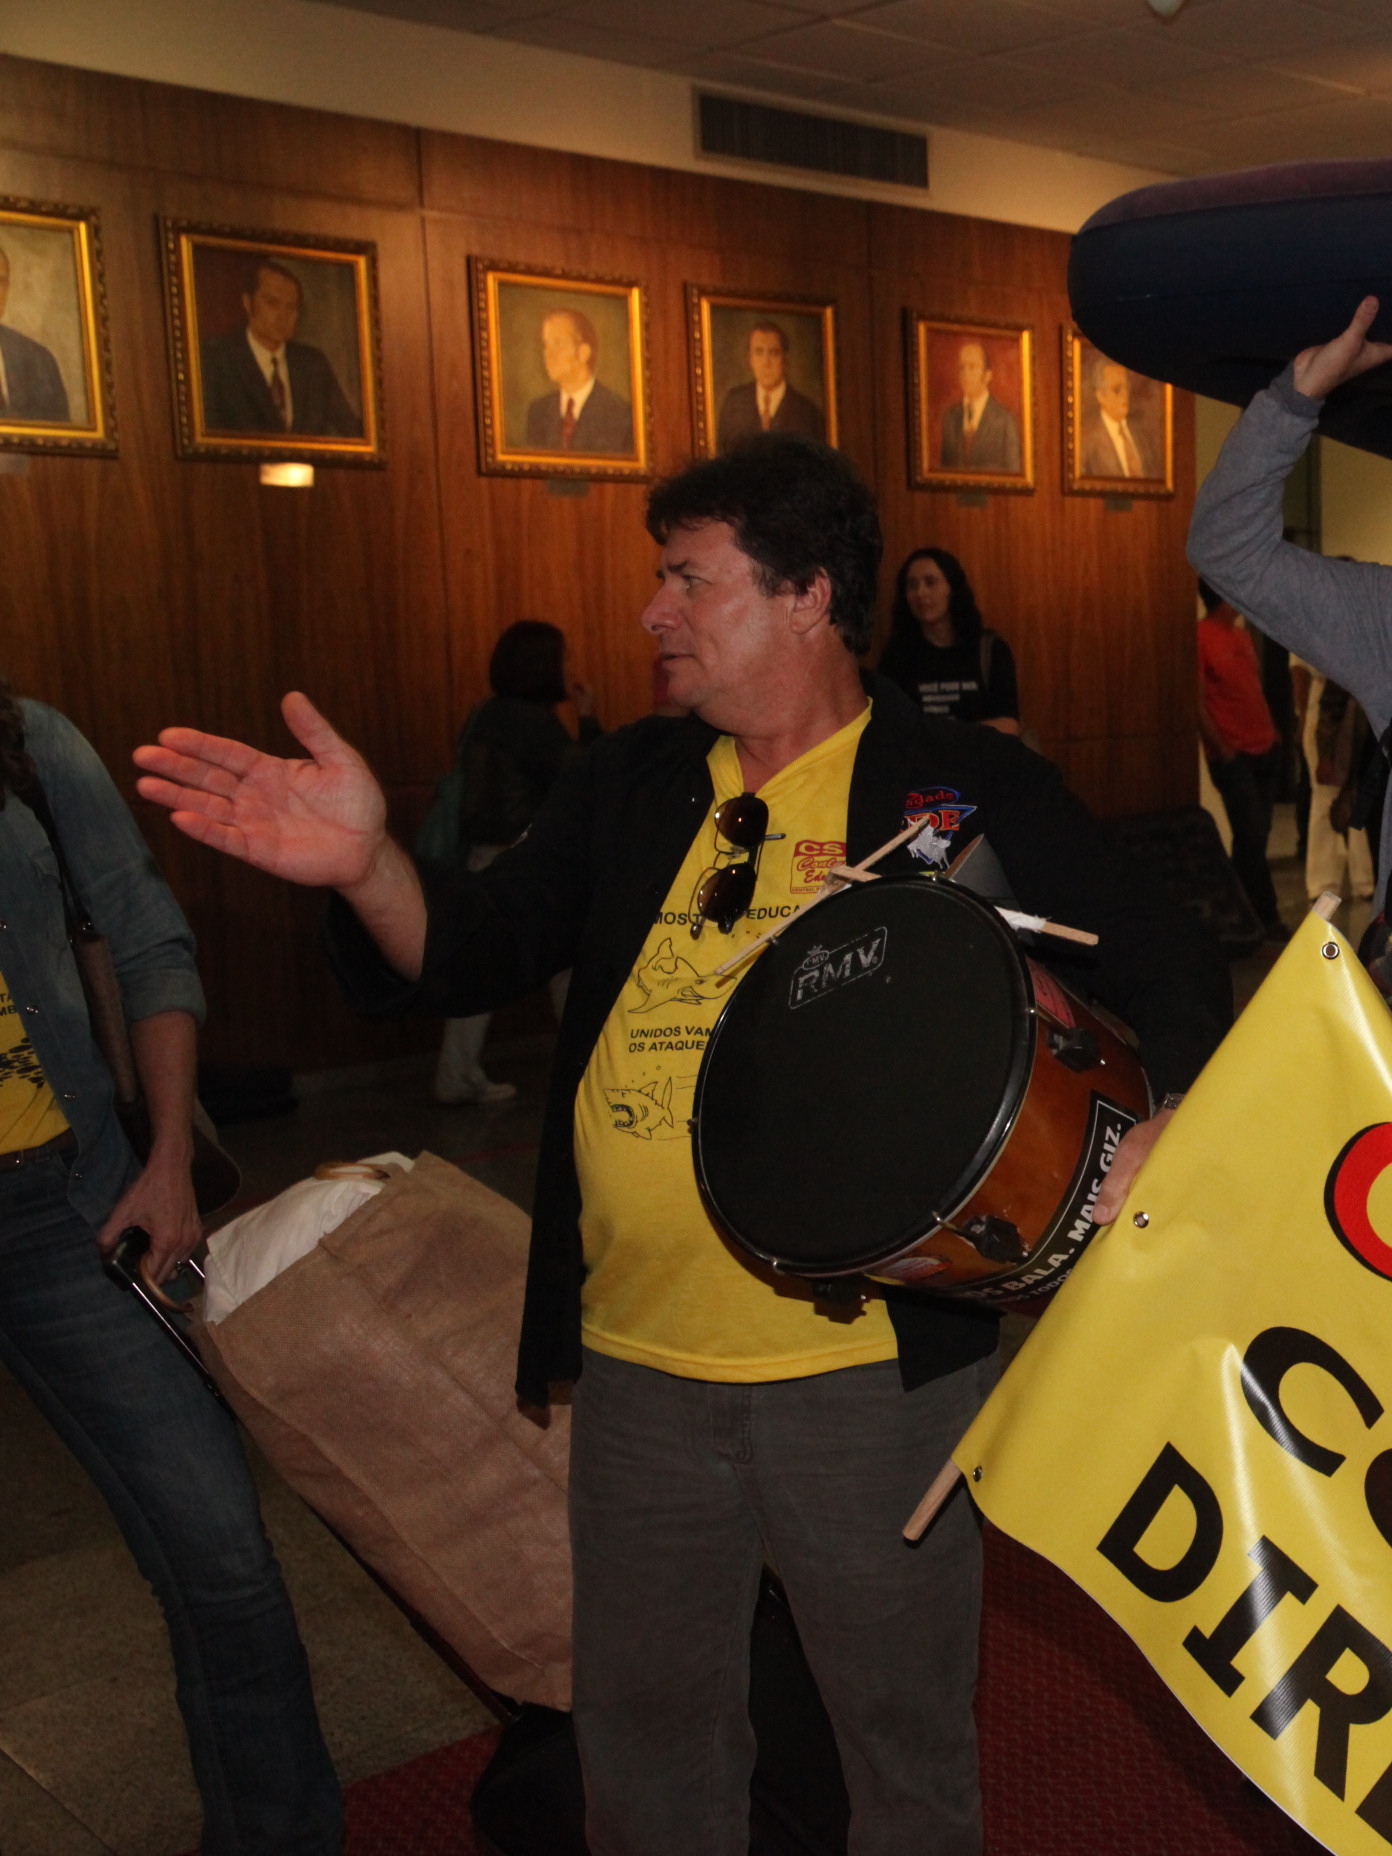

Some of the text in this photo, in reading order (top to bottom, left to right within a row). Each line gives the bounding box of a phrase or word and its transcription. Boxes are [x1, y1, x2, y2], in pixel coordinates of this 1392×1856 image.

[798, 842, 844, 855] CS
[796, 938, 882, 1001] RMV
[630, 1025, 713, 1039] UNIDOS VAM
[628, 1039, 707, 1053] OS ATAQUE
